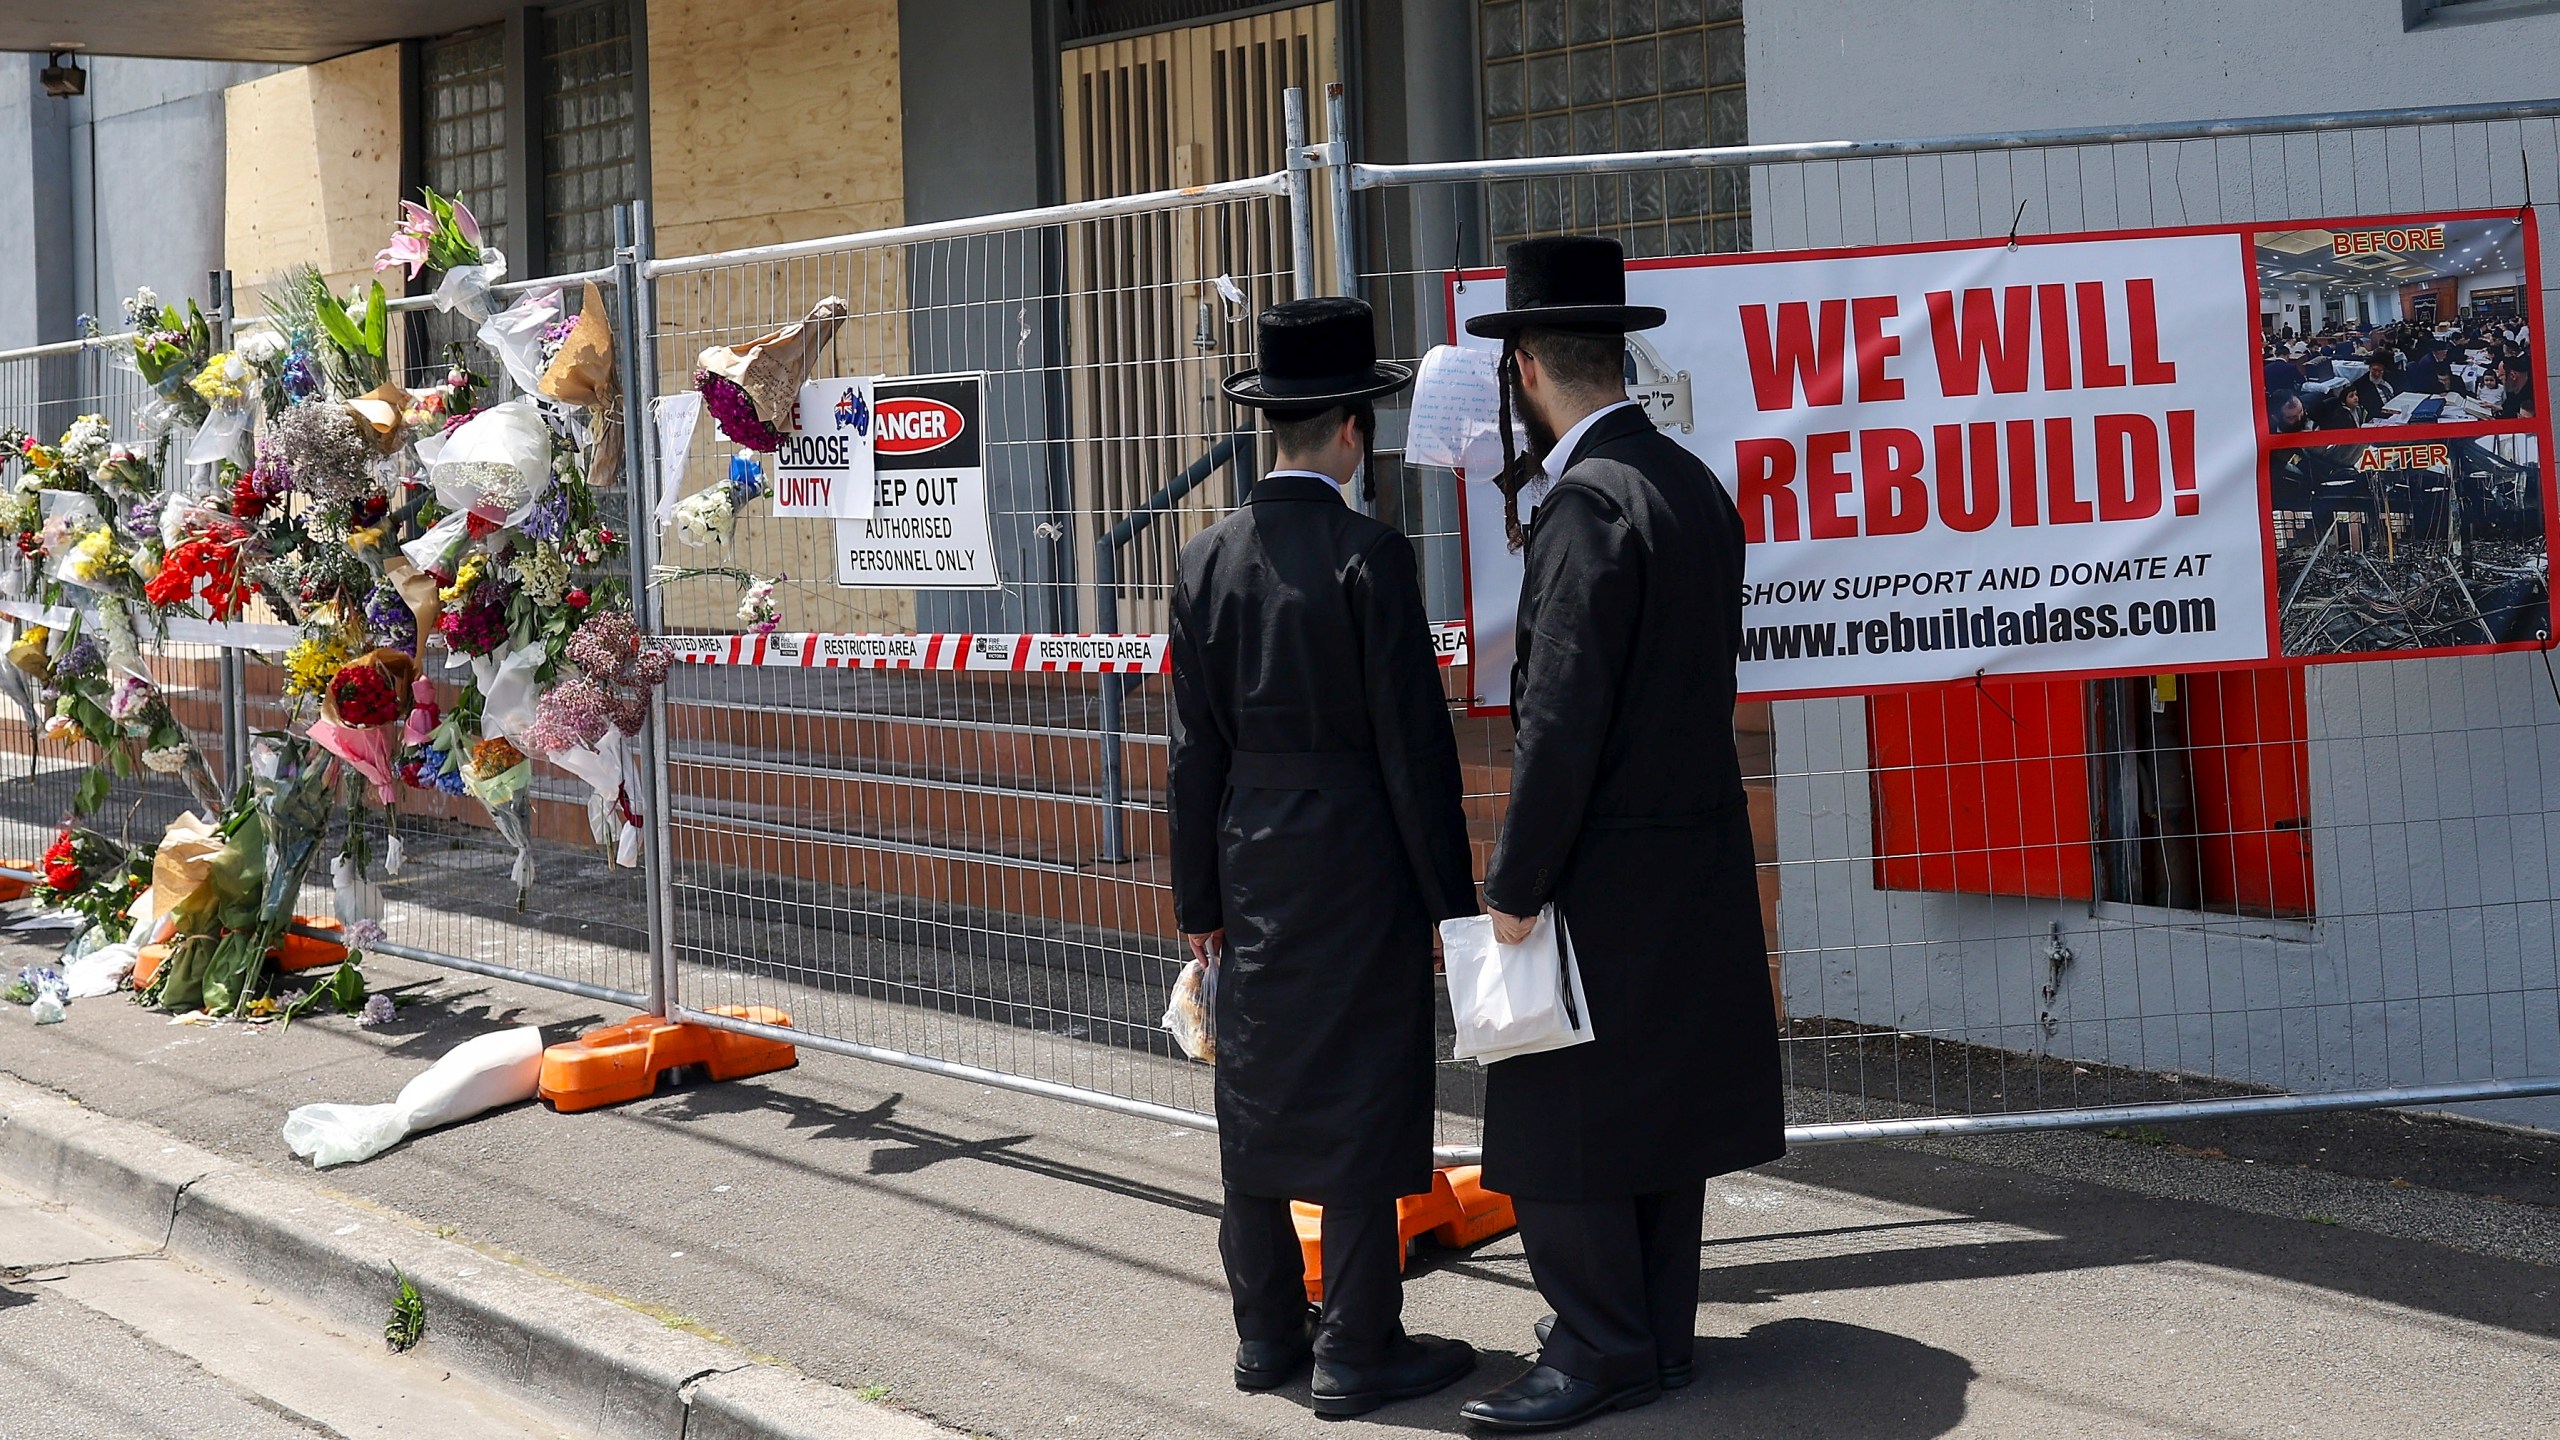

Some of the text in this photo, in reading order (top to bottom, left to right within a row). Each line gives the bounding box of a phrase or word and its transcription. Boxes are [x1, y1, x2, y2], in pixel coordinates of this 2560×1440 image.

[2332, 227, 2445, 256] BEFORE
[1738, 278, 2177, 412] WE WILL
[791, 402, 803, 430] E
[874, 410, 947, 441] ANGER
[779, 435, 849, 465] CHOOSE
[2359, 443, 2449, 472] AFTER
[1735, 408, 2200, 544] REBUILD!
[779, 478, 831, 507] UNITY
[874, 477, 958, 506] EP OUT
[865, 517, 952, 539] AUTHORISED
[850, 550, 975, 571] PERSONNEL ONLY
[1740, 554, 2212, 606] SHOW SUPPORT AND DONATE AT
[1431, 631, 1467, 651] REA
[1738, 596, 2217, 662] www.rebuildadass.com
[699, 638, 723, 652] AREA
[824, 640, 917, 656] RESTRICTED AREA
[1040, 641, 1152, 659] RESTRICTED AREA
